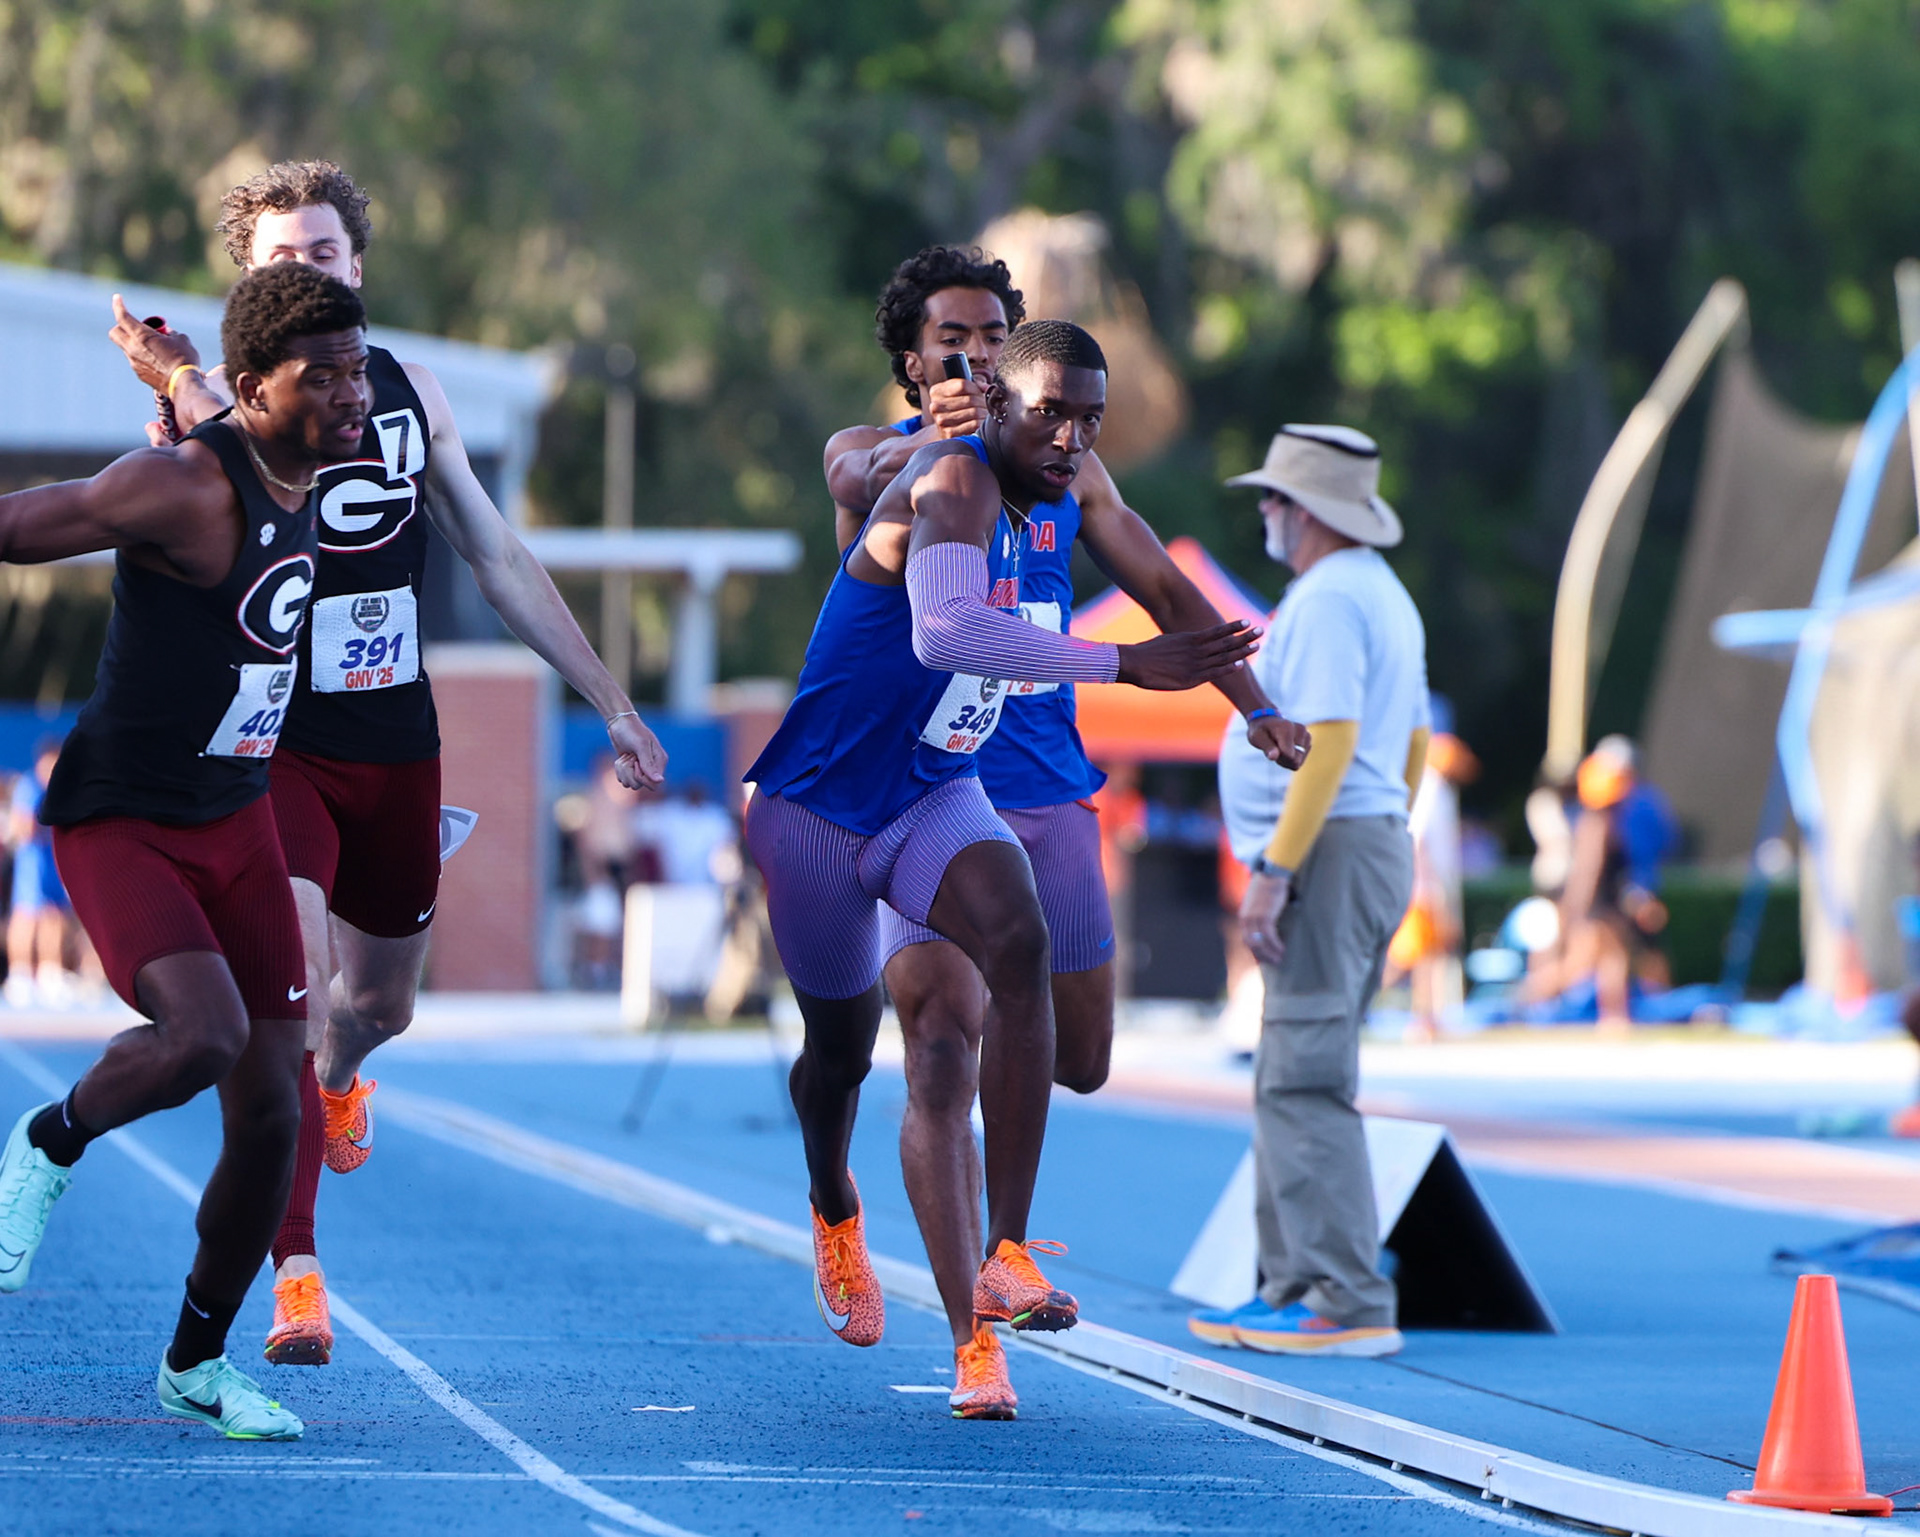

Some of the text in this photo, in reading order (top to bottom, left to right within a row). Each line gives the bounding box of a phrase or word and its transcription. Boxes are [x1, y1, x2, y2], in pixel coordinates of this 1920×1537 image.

[380, 414, 410, 475] 7
[318, 468, 418, 543] G
[339, 632, 404, 669] 391
[345, 669, 374, 689] GNV
[948, 704, 996, 735] 349
